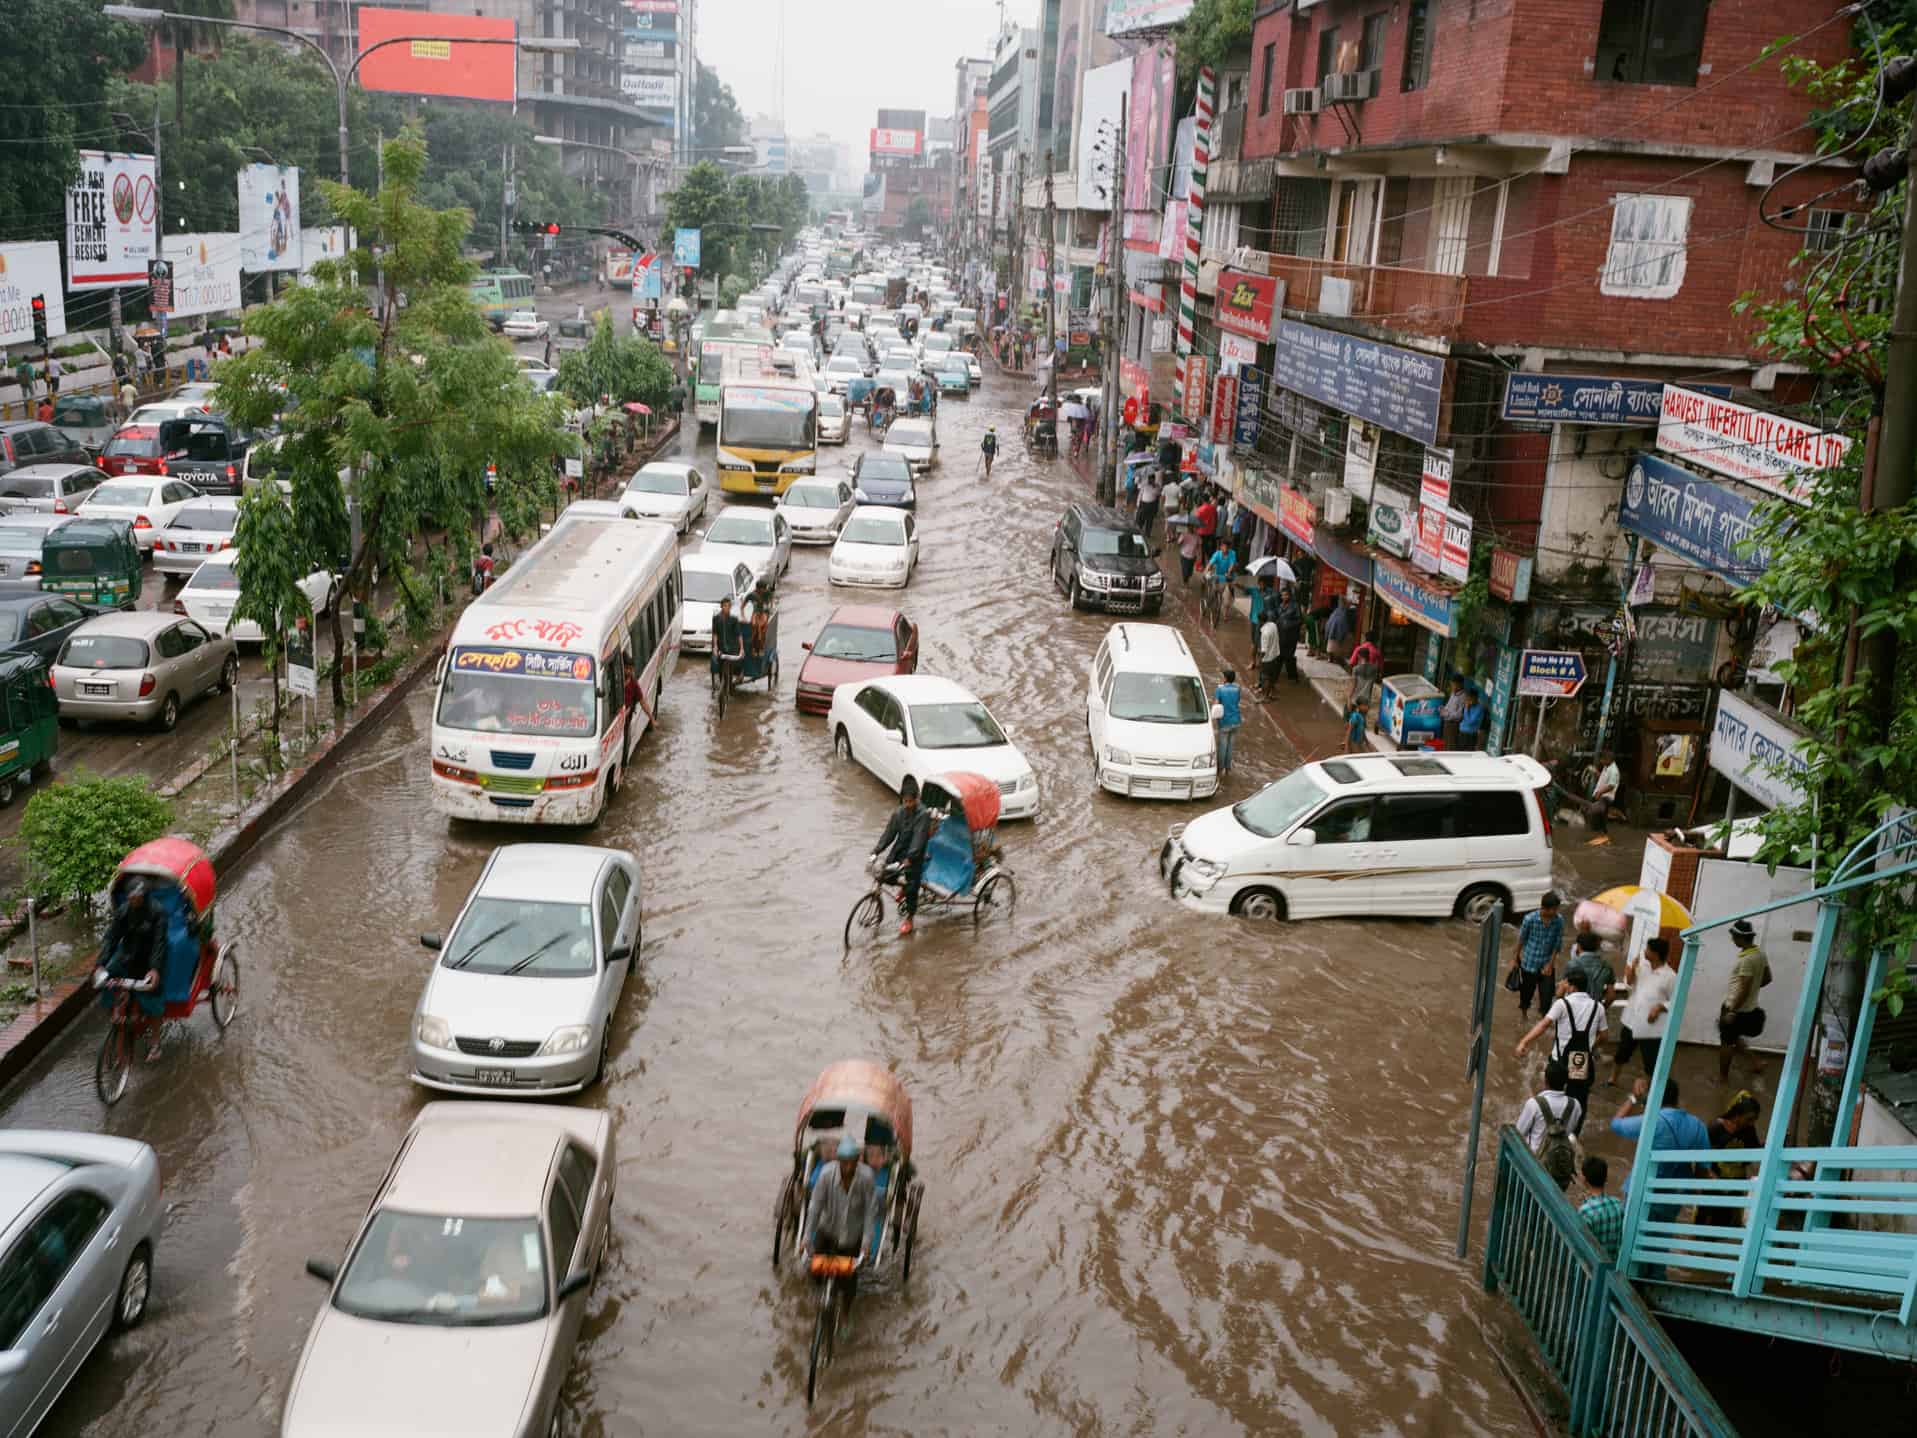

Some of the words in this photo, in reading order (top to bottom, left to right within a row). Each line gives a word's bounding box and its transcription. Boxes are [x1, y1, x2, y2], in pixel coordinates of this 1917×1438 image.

[73, 191, 106, 223] FREE
[74, 224, 107, 242] CEMENT
[74, 243, 108, 262] RESISTS
[1573, 381, 1624, 409] সোনালী
[1626, 388, 1665, 413] ব্যাংক
[1663, 390, 1704, 425] HARVEST
[1704, 402, 1774, 448] INFERTILITY
[1775, 423, 1812, 463] CARE
[1815, 434, 1844, 470] LTD
[176, 472, 218, 481] TOYOTA
[1647, 475, 1681, 526] আরব
[1679, 482, 1717, 542] মিশন
[1529, 664, 1557, 675] Block
[1559, 666, 1566, 675] #
[1568, 667, 1576, 676] A
[1717, 708, 1749, 753] মাদার
[1749, 730, 1785, 767] কেয়ার
[560, 753, 588, 770] الله
